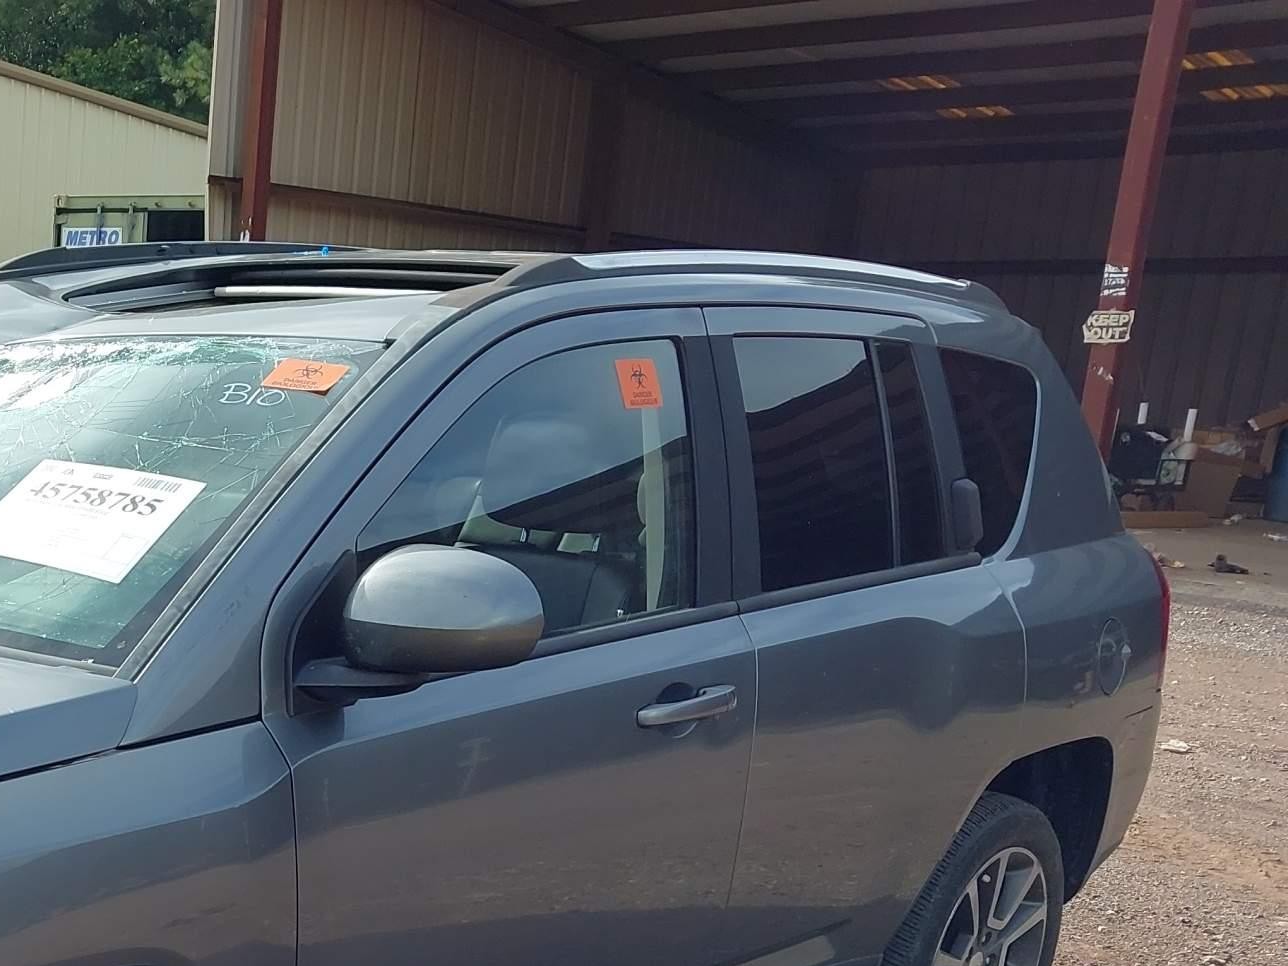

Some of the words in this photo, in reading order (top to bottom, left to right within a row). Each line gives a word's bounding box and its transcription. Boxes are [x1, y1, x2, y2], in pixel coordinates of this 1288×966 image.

[65, 230, 120, 246] METRO
[1087, 314, 1130, 327] KEEP
[1091, 327, 1127, 340] OUT
[218, 383, 286, 406] BIO
[29, 480, 165, 517] 45758785
